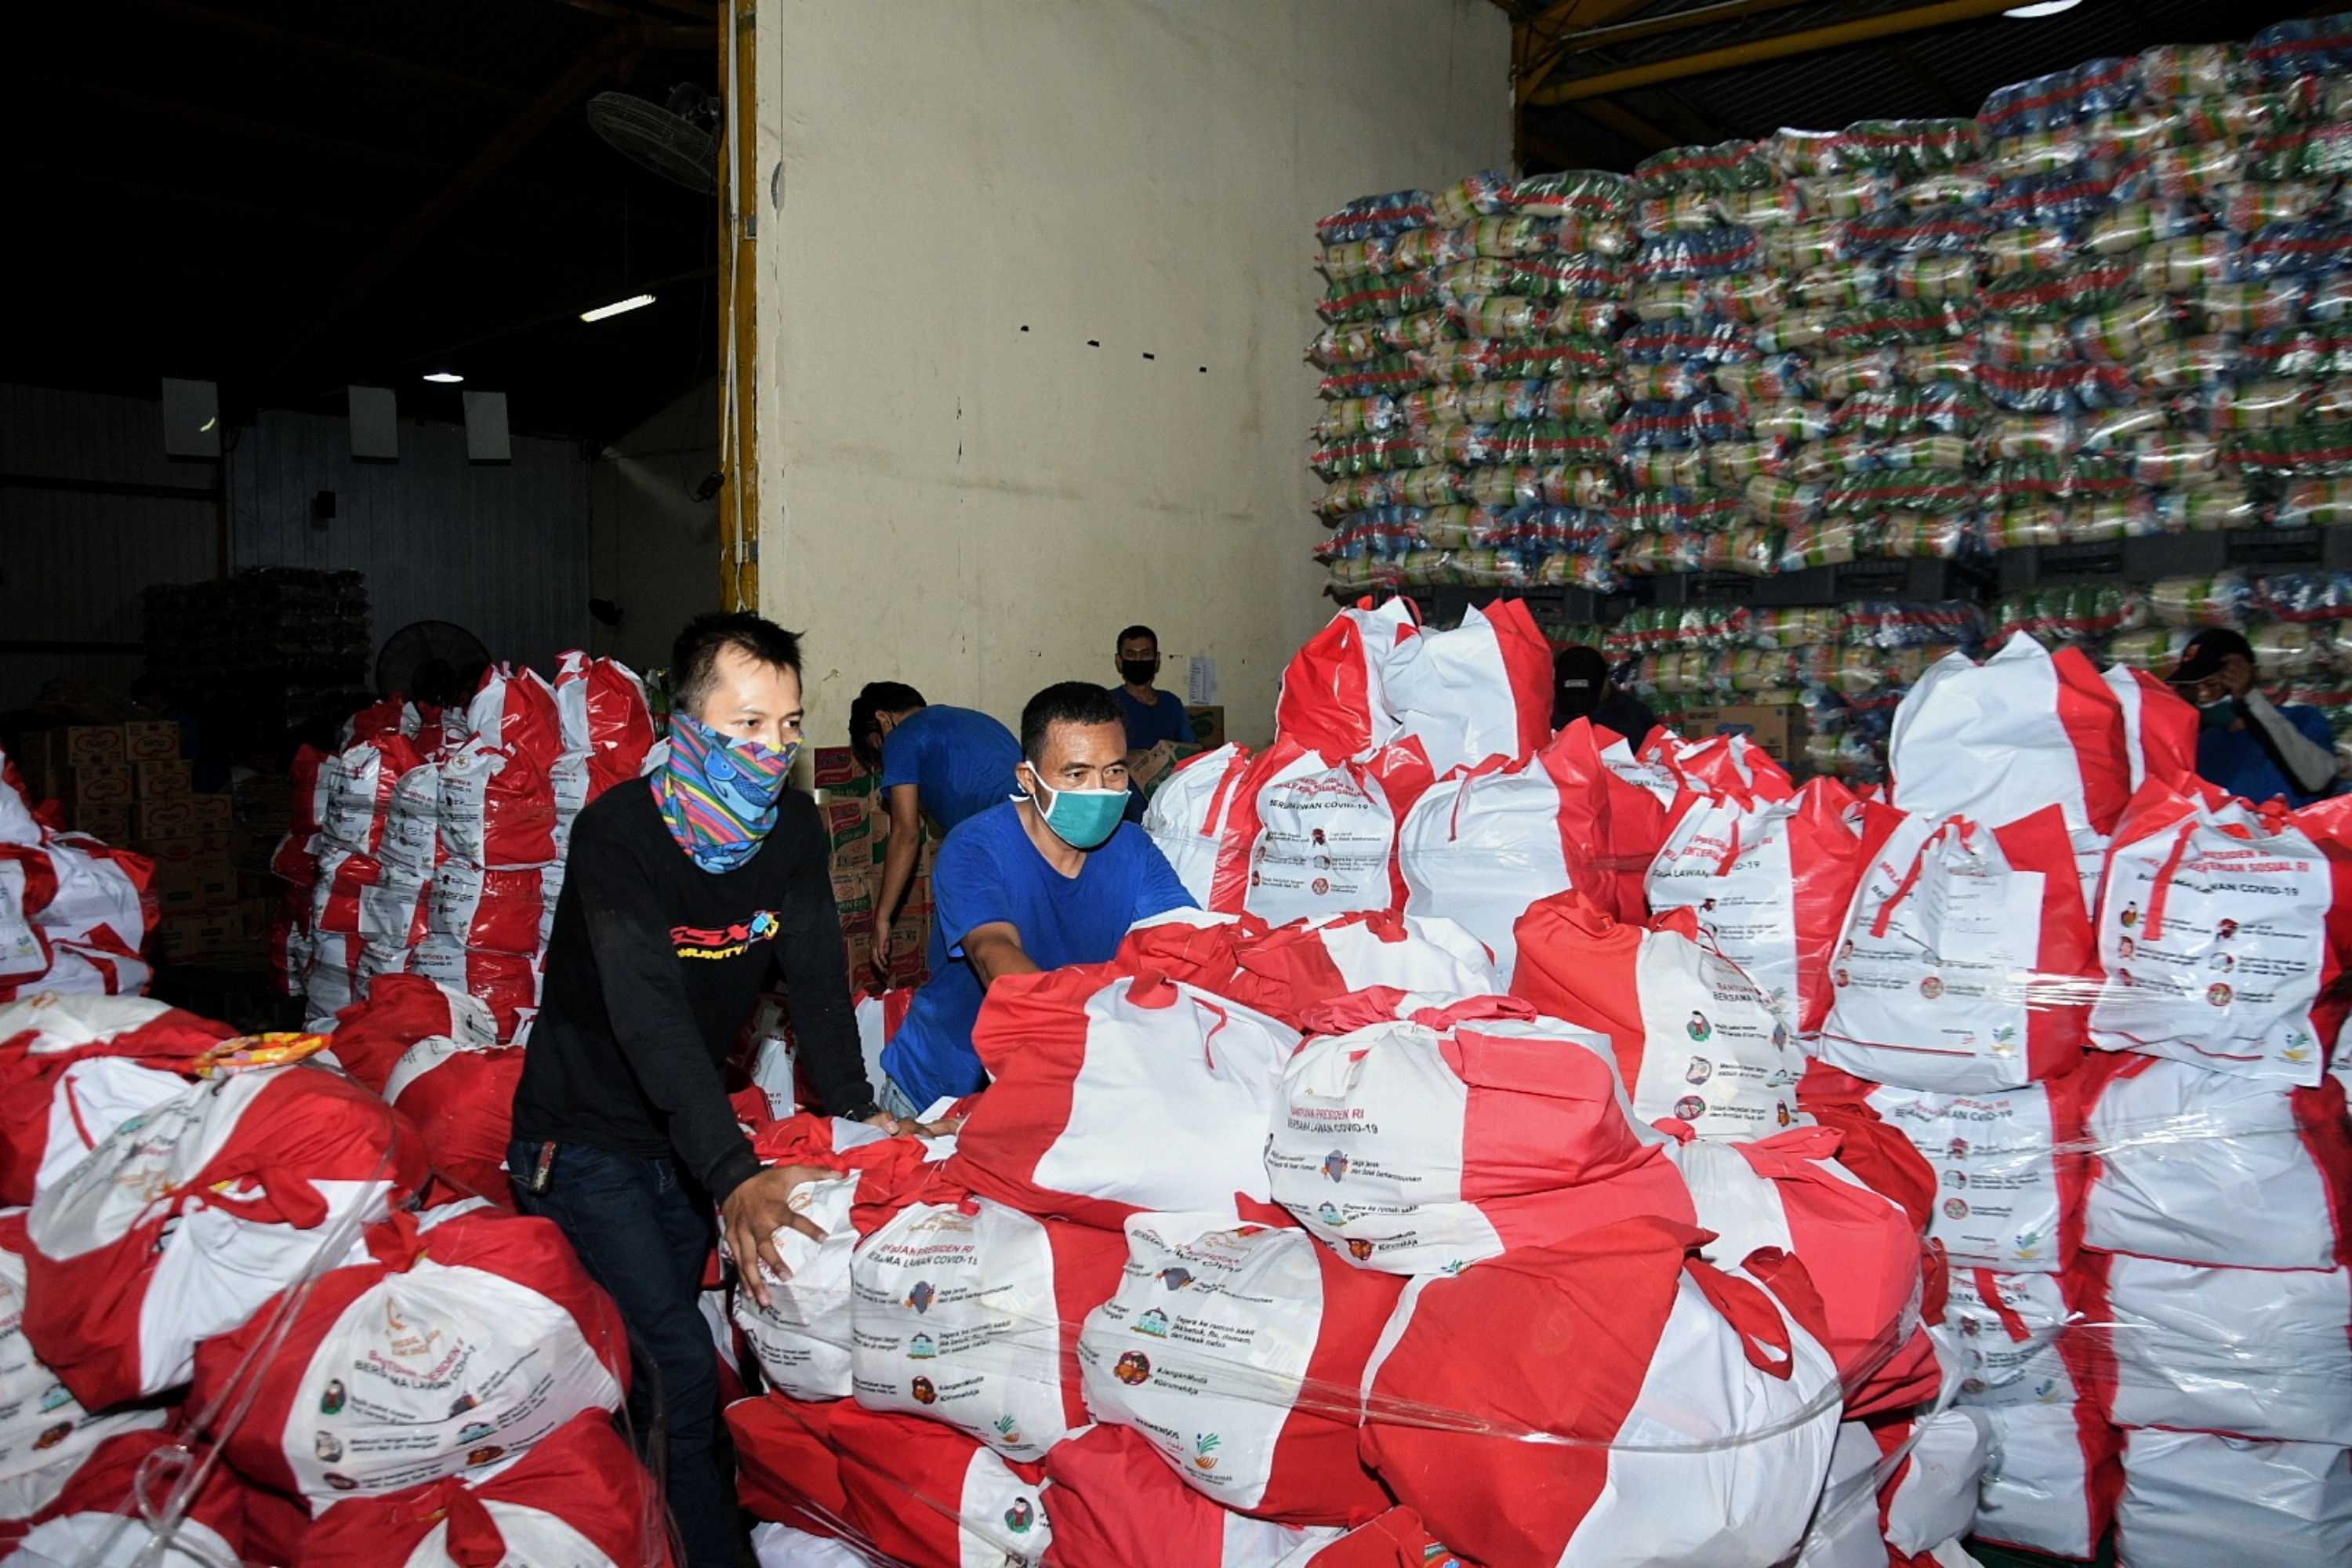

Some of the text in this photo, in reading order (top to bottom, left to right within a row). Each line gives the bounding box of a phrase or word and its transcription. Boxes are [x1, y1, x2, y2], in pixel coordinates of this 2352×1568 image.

[2238, 883, 2299, 897] COVID-19
[1712, 991, 1753, 1003] BERSAMA
[1352, 1109, 1364, 1119] RI
[1334, 1123, 1379, 1134] COVID-19
